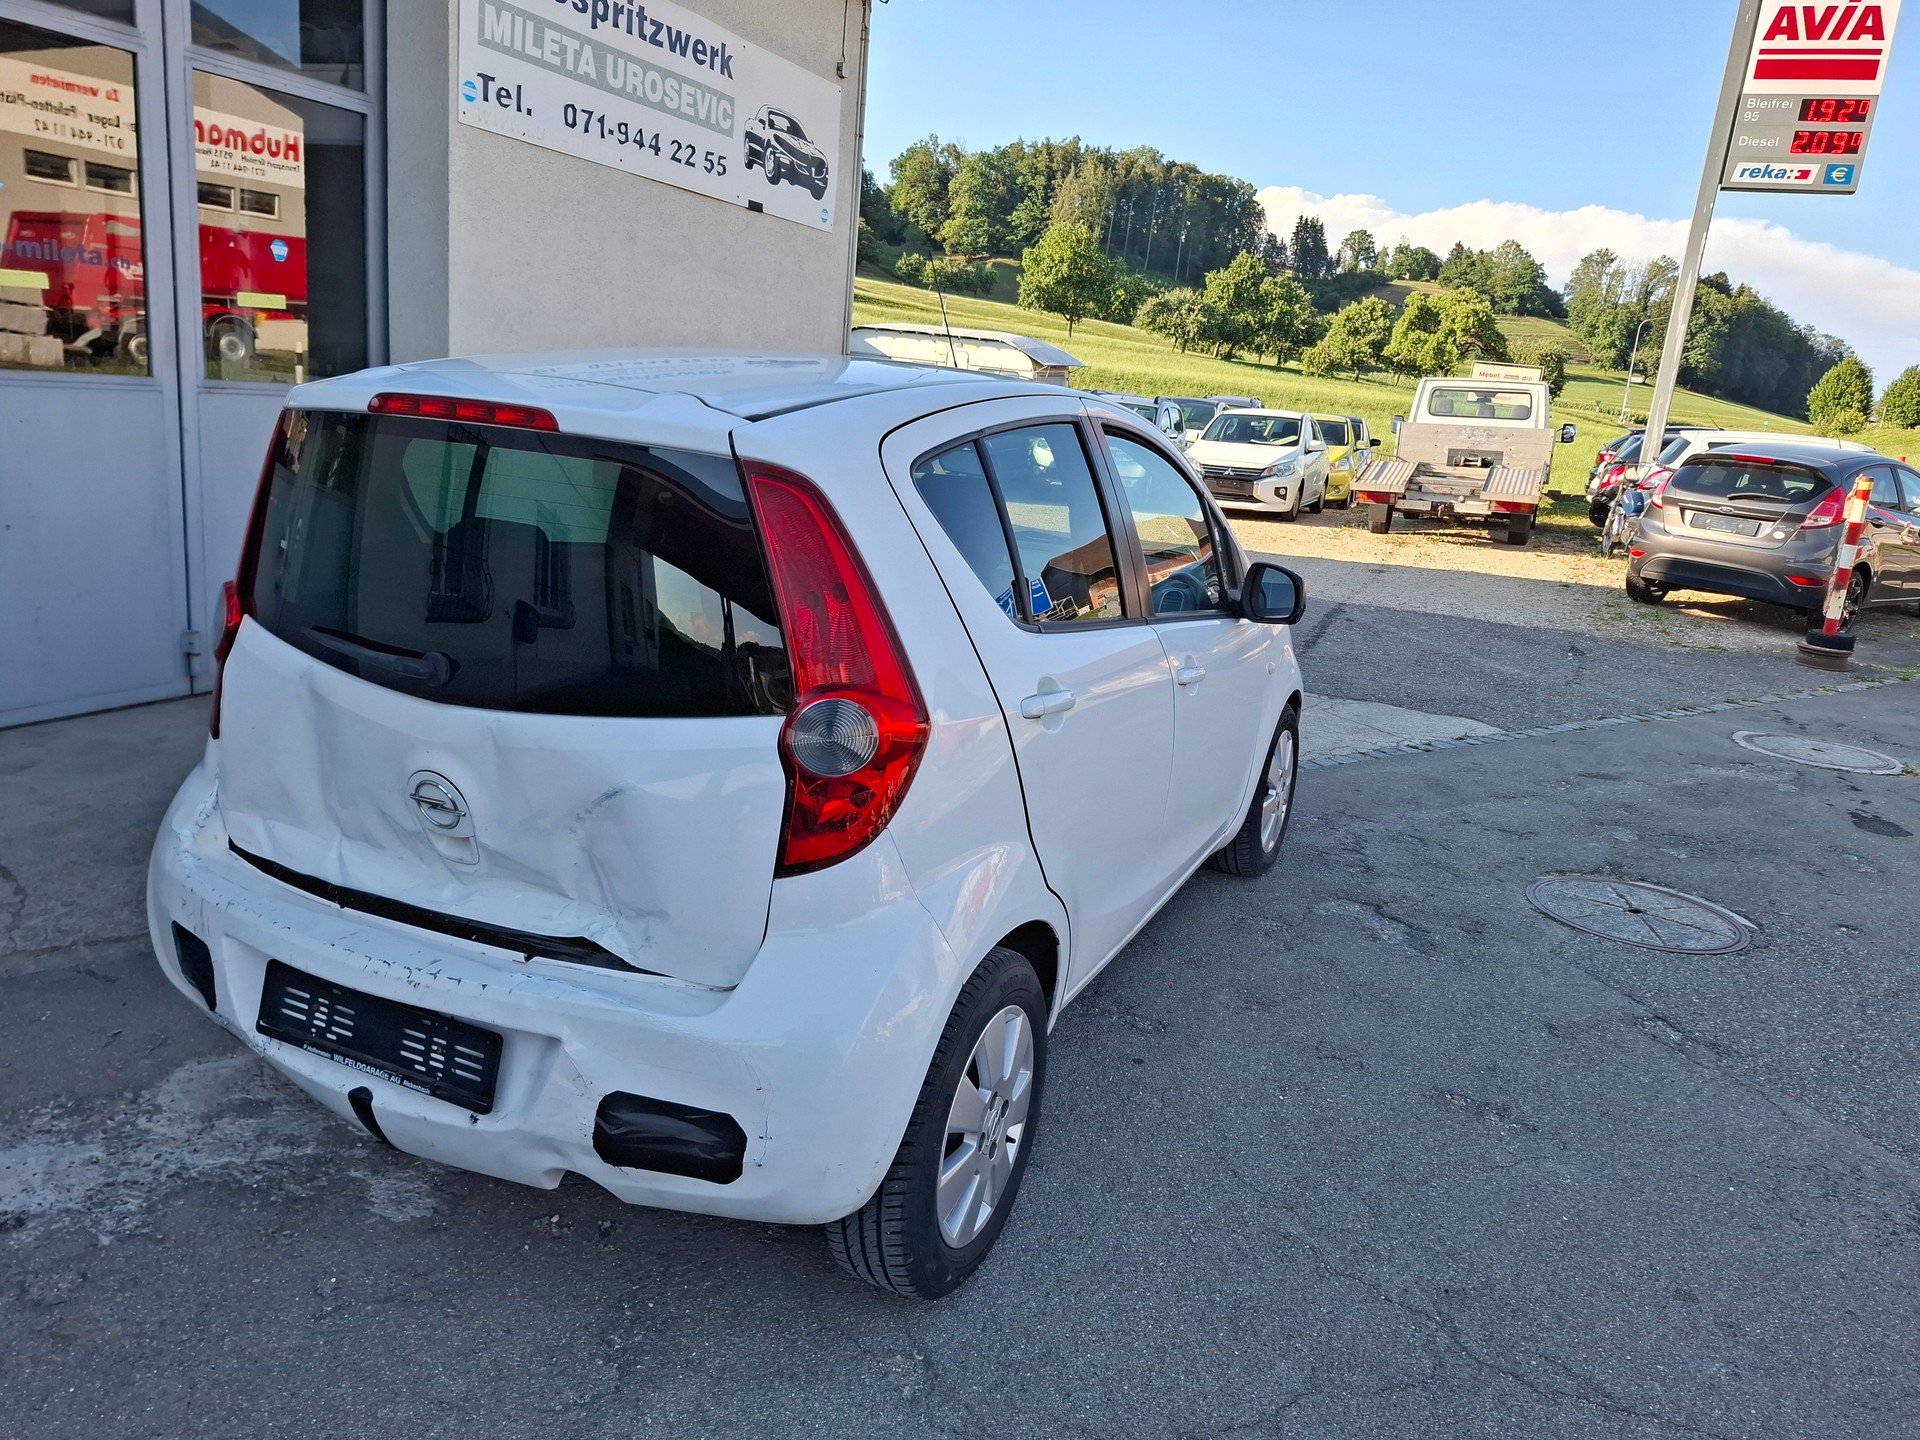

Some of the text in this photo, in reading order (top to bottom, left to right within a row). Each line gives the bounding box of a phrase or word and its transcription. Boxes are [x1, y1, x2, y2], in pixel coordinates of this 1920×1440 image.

[1762, 3, 1885, 41] AVIA
[553, 0, 733, 80] spritzwerk
[484, 4, 732, 130] MILETA UROSEVIC
[1746, 98, 1794, 109] Bleifrei
[477, 73, 533, 116] Tel.
[563, 103, 661, 156] 071-944
[670, 139, 696, 168] 22
[703, 151, 727, 176] 55
[1743, 111, 1760, 122] 95
[1738, 136, 1780, 148] Diesel
[390, 1074, 401, 1085] AG
